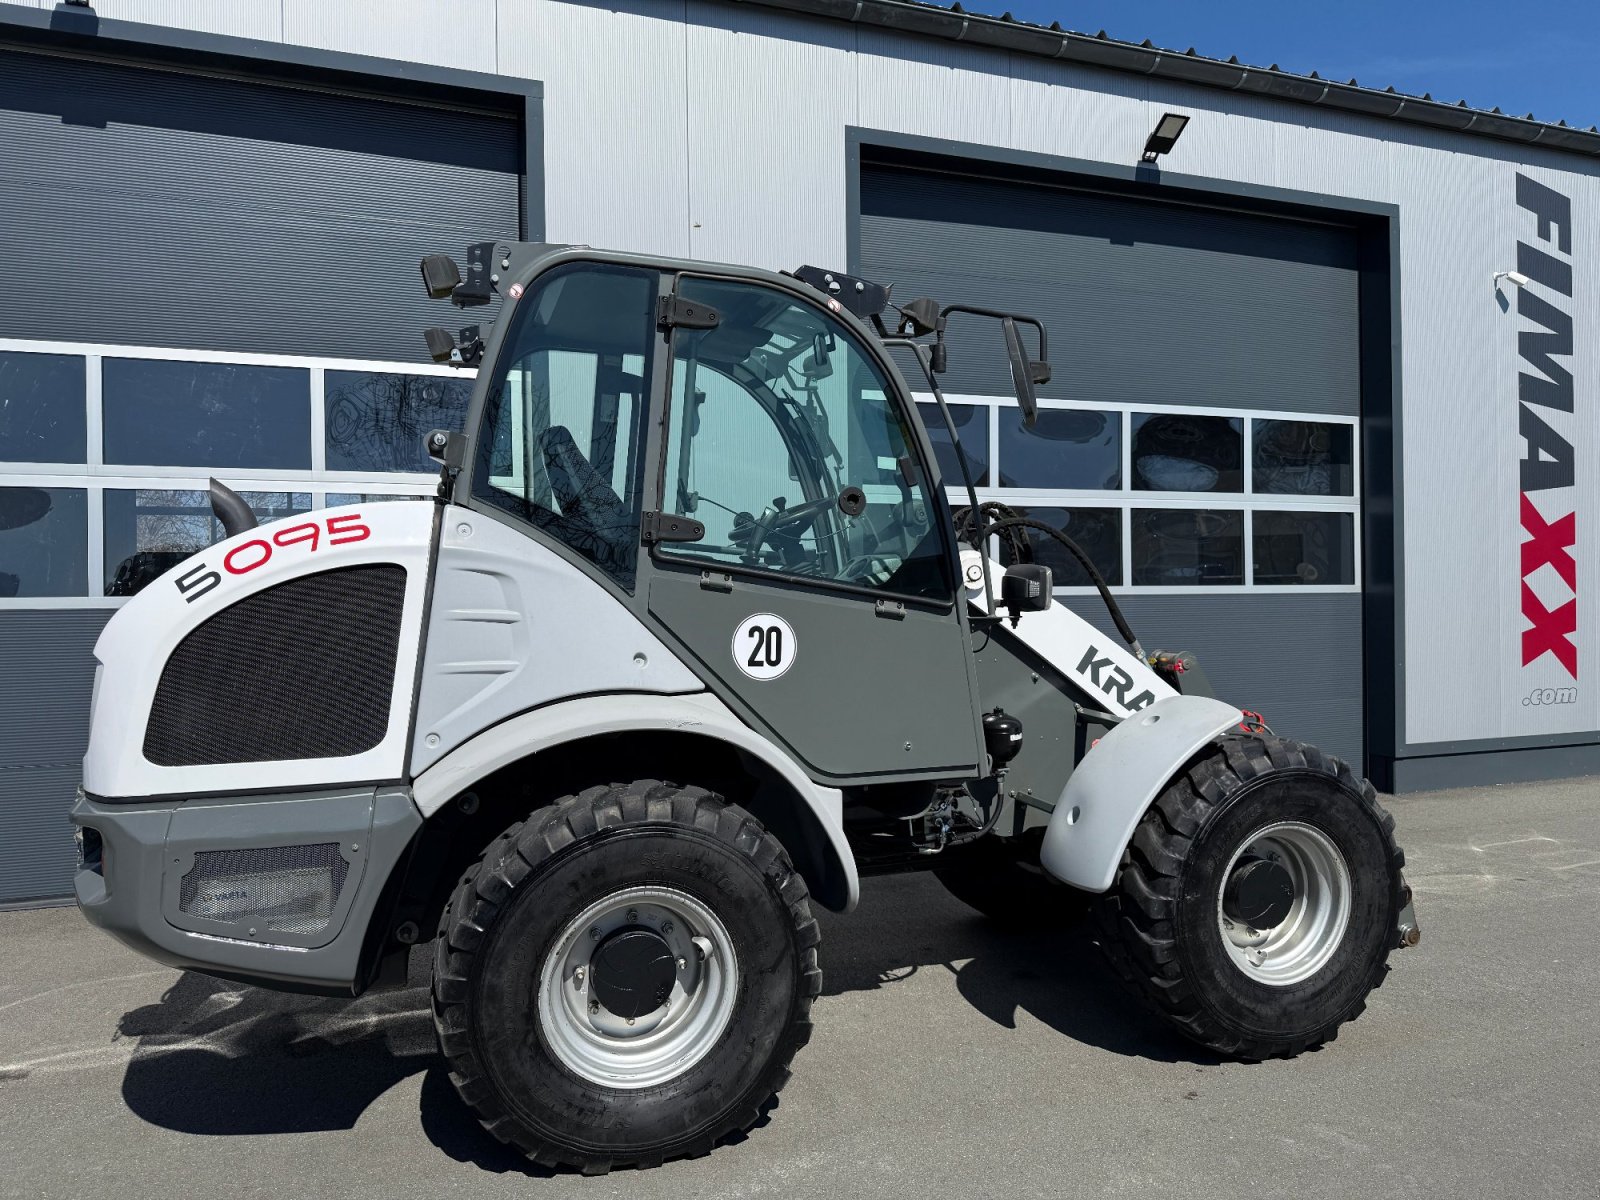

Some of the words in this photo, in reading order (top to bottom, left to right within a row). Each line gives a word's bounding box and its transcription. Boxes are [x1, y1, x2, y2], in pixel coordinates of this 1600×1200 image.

[1516, 172, 1577, 681] FIMAXX
[174, 513, 371, 604] 5095
[747, 625, 782, 667] 20
[1522, 687, 1577, 706] .com
